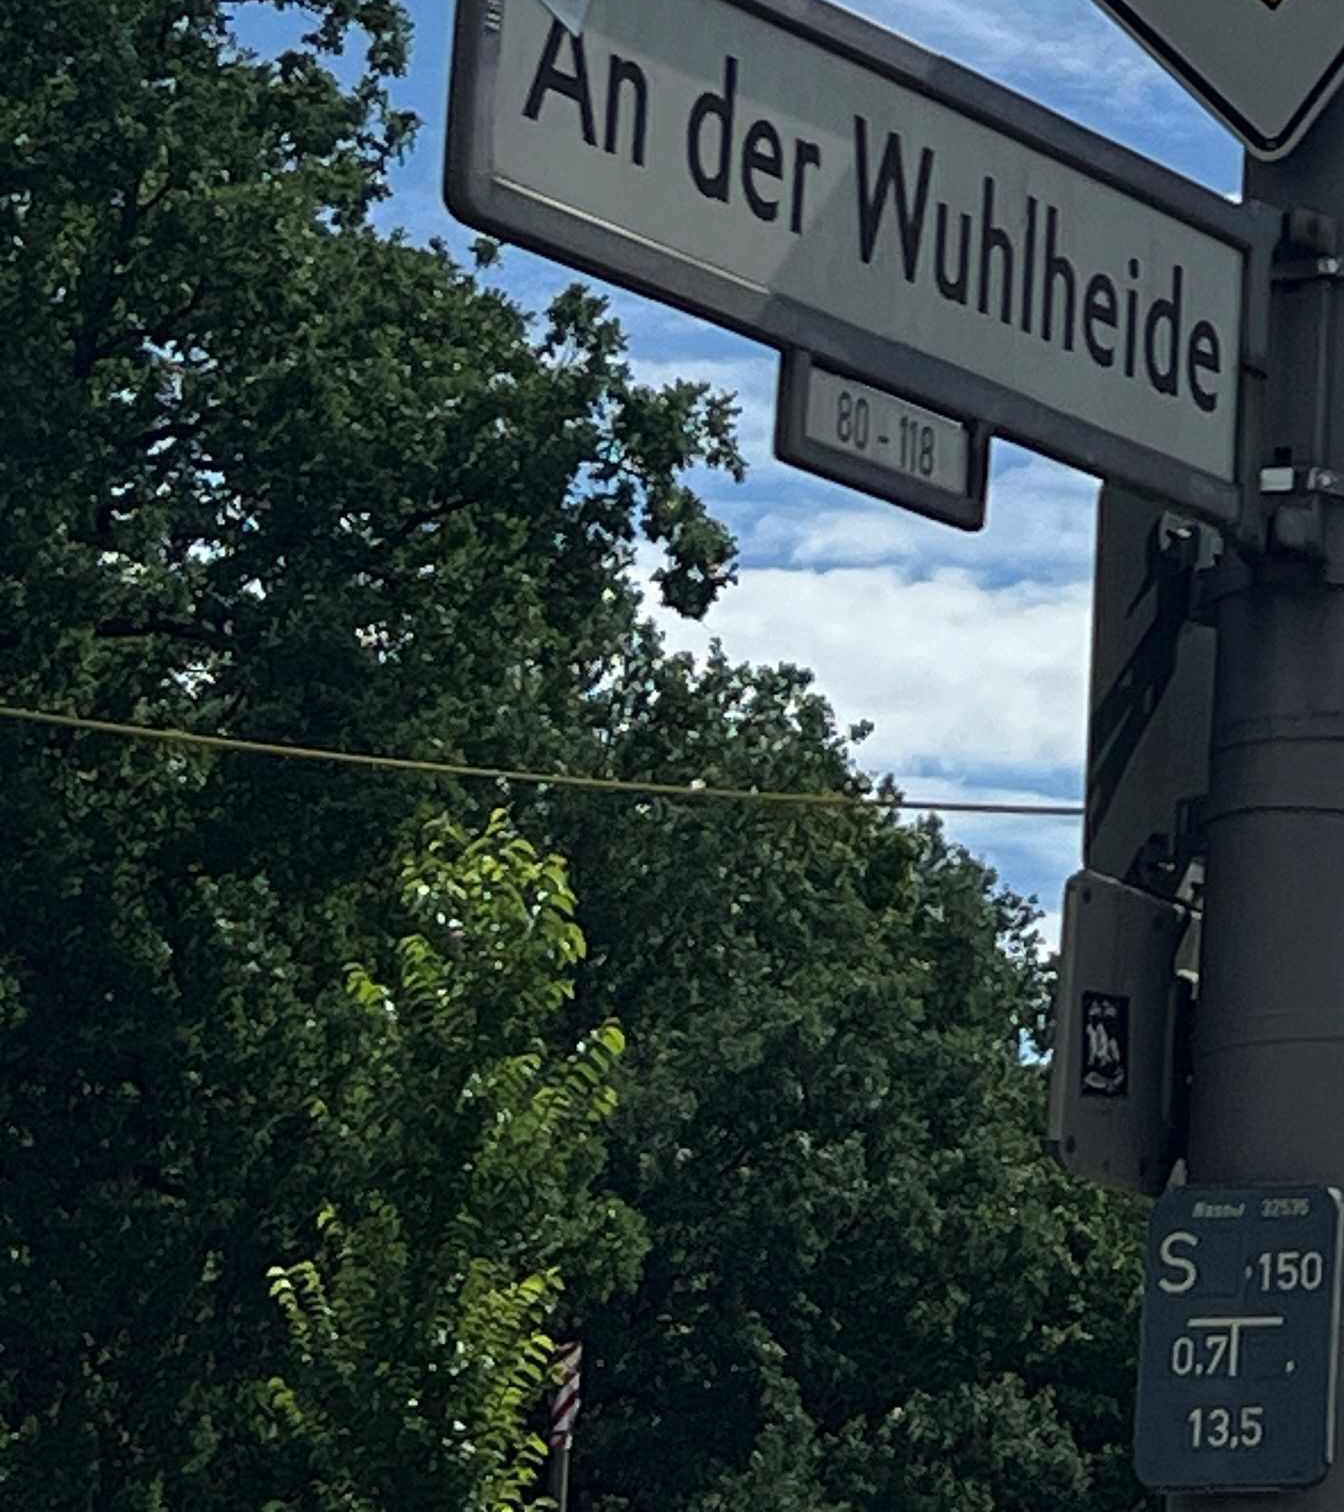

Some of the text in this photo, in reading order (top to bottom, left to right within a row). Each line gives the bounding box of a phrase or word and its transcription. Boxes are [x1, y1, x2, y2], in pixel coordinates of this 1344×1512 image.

[521, 17, 1222, 413] An der Wuhlheide
[837, 390, 870, 450] 80
[900, 416, 935, 477] 118
[1158, 1231, 1199, 1293] S
[1188, 1406, 1264, 1449] 13,5
